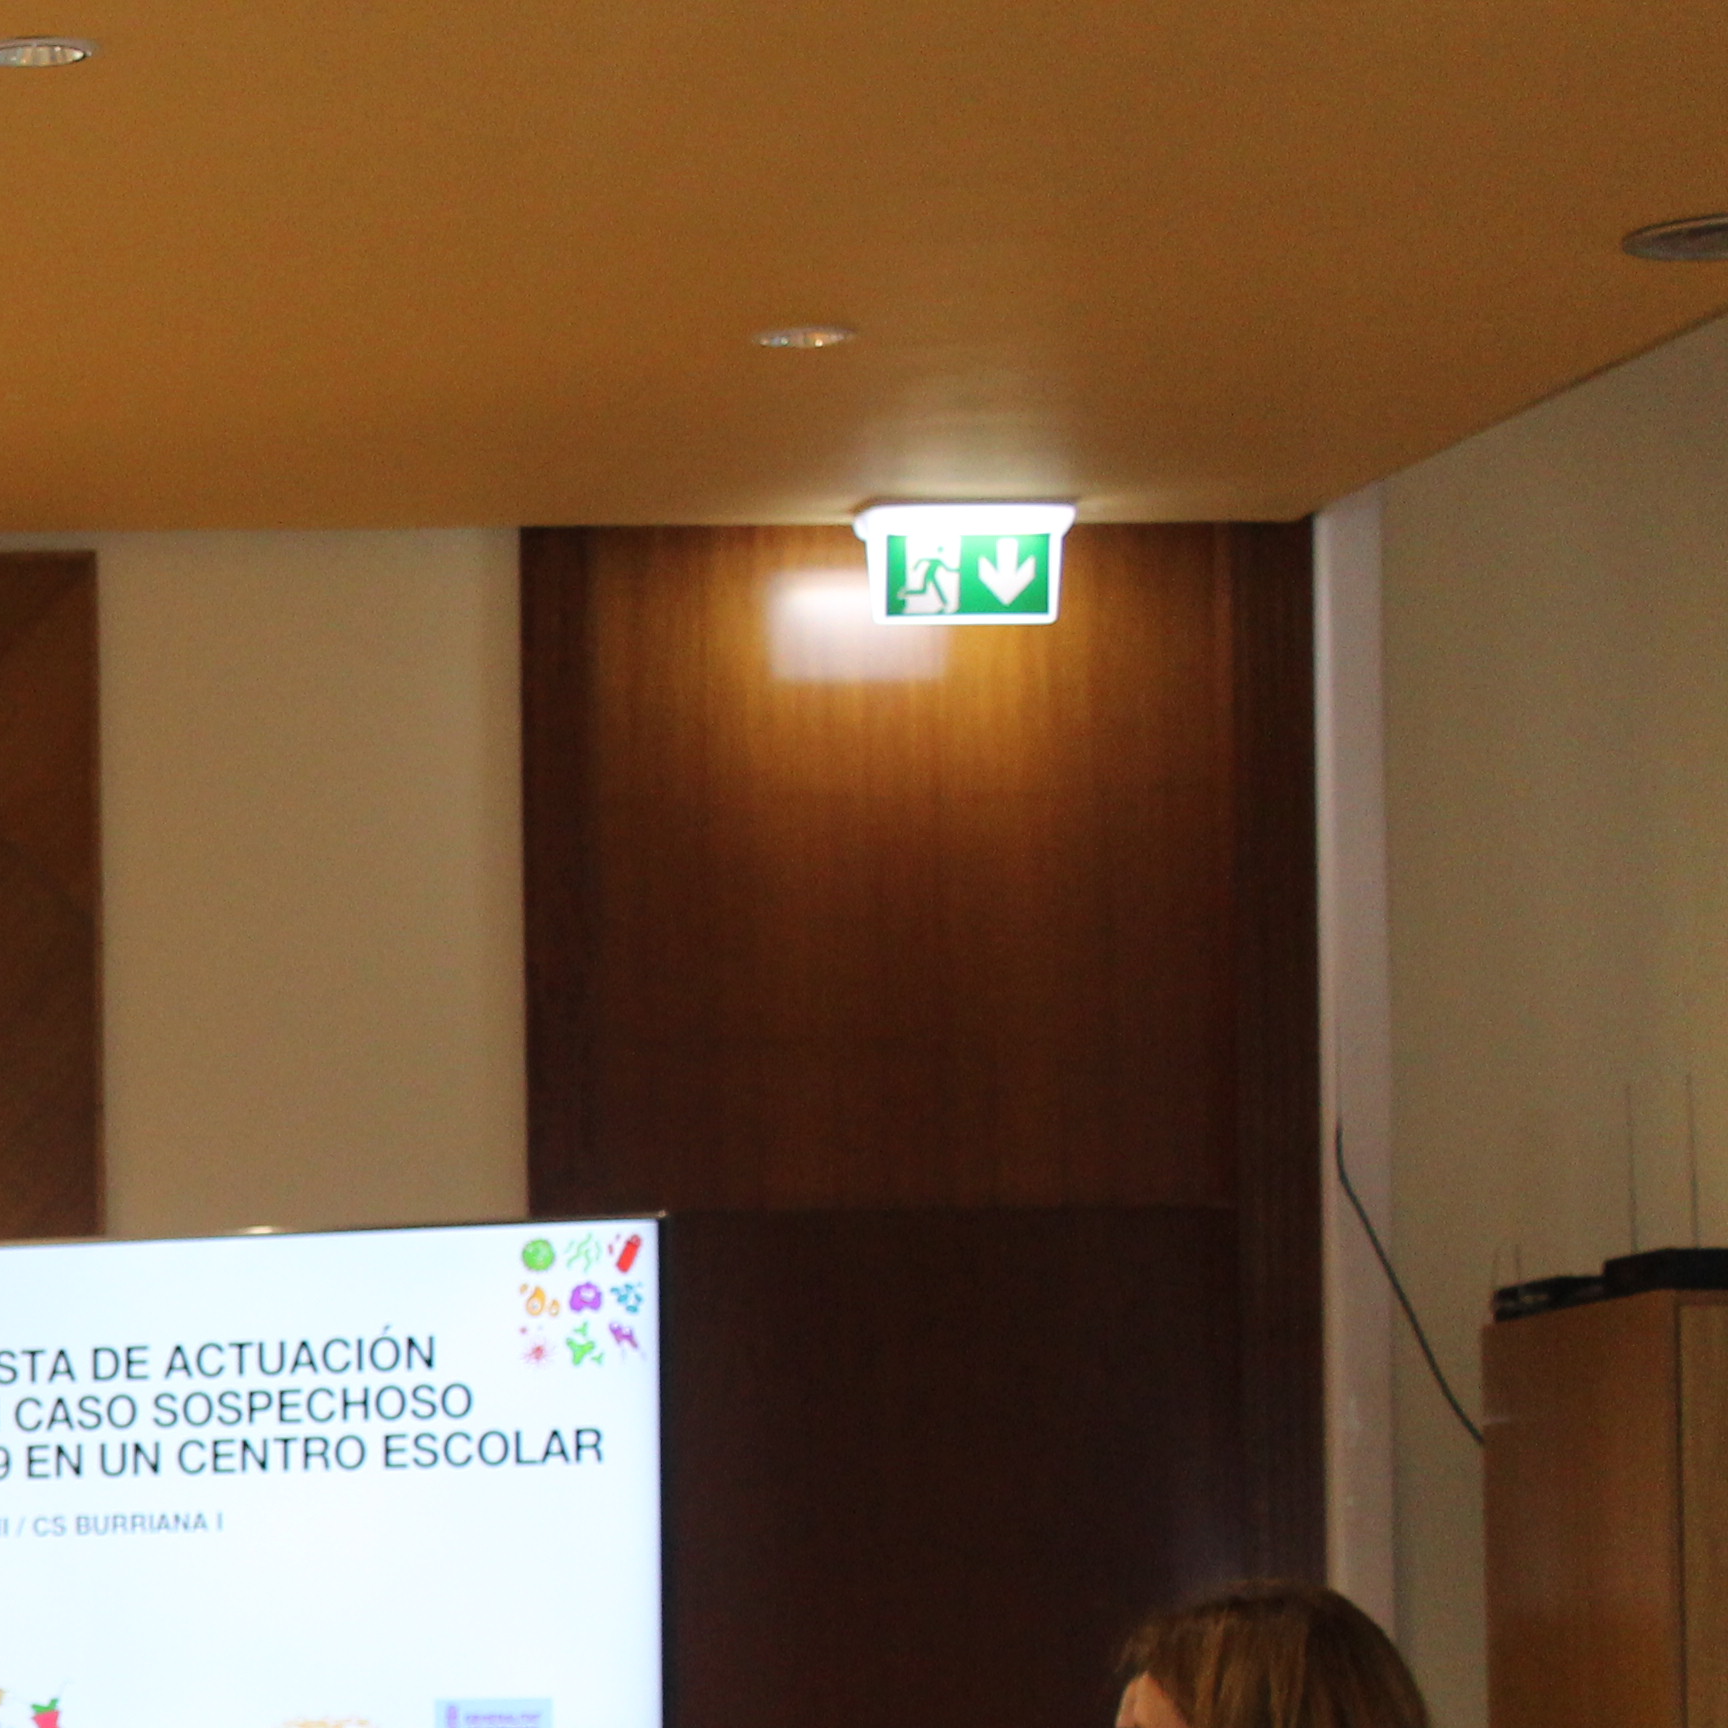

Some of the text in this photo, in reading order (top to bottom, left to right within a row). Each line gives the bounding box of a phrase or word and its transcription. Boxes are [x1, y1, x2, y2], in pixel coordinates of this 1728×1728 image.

[92, 1344, 152, 1383] DE
[164, 1324, 436, 1381] ACTUACIÓN
[13, 1392, 140, 1434] CASO
[152, 1381, 475, 1428] SOSPECHOSO
[26, 1442, 85, 1480] EN
[100, 1440, 162, 1478] UN
[176, 1433, 369, 1477] CENTRO
[383, 1427, 605, 1470] ESCOLAR
[32, 1512, 68, 1538] CS
[75, 1509, 209, 1537] BURRIANA
